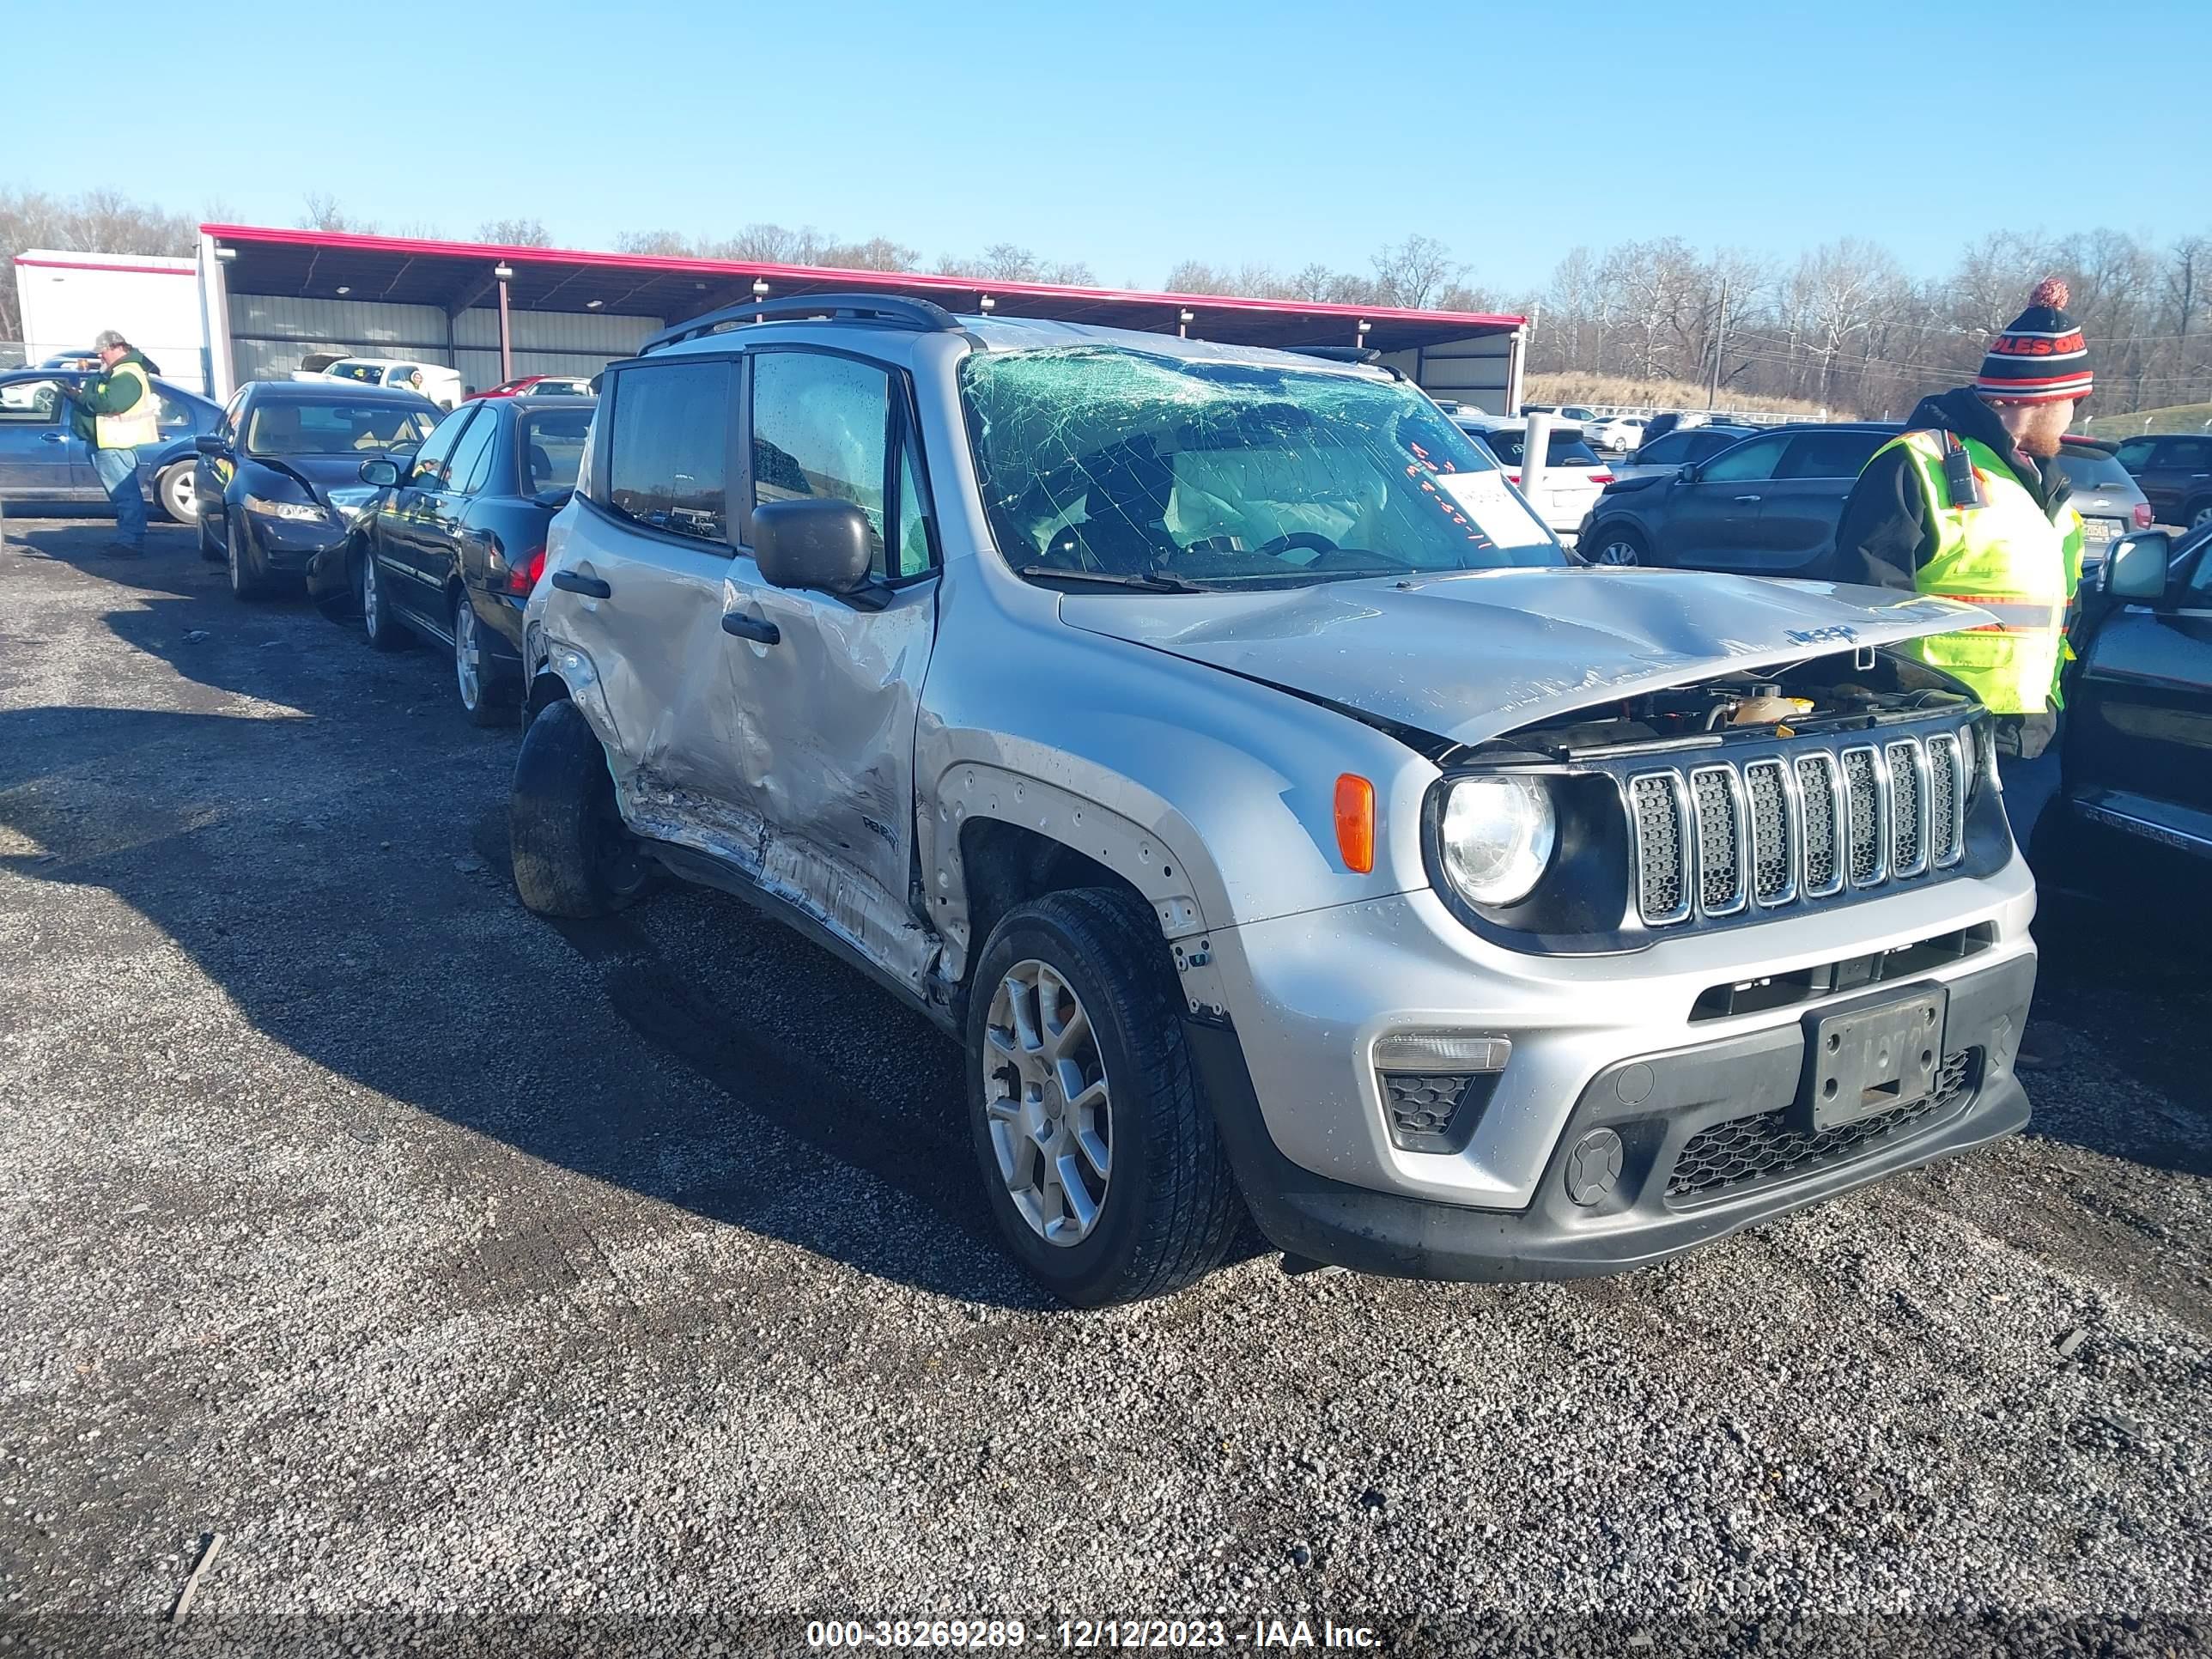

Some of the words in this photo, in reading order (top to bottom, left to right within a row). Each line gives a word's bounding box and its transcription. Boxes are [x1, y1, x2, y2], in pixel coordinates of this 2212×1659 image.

[1784, 625, 1859, 647] Jeep
[2086, 809, 2123, 829] GRAND
[2128, 822, 2189, 849] CHEROKEE
